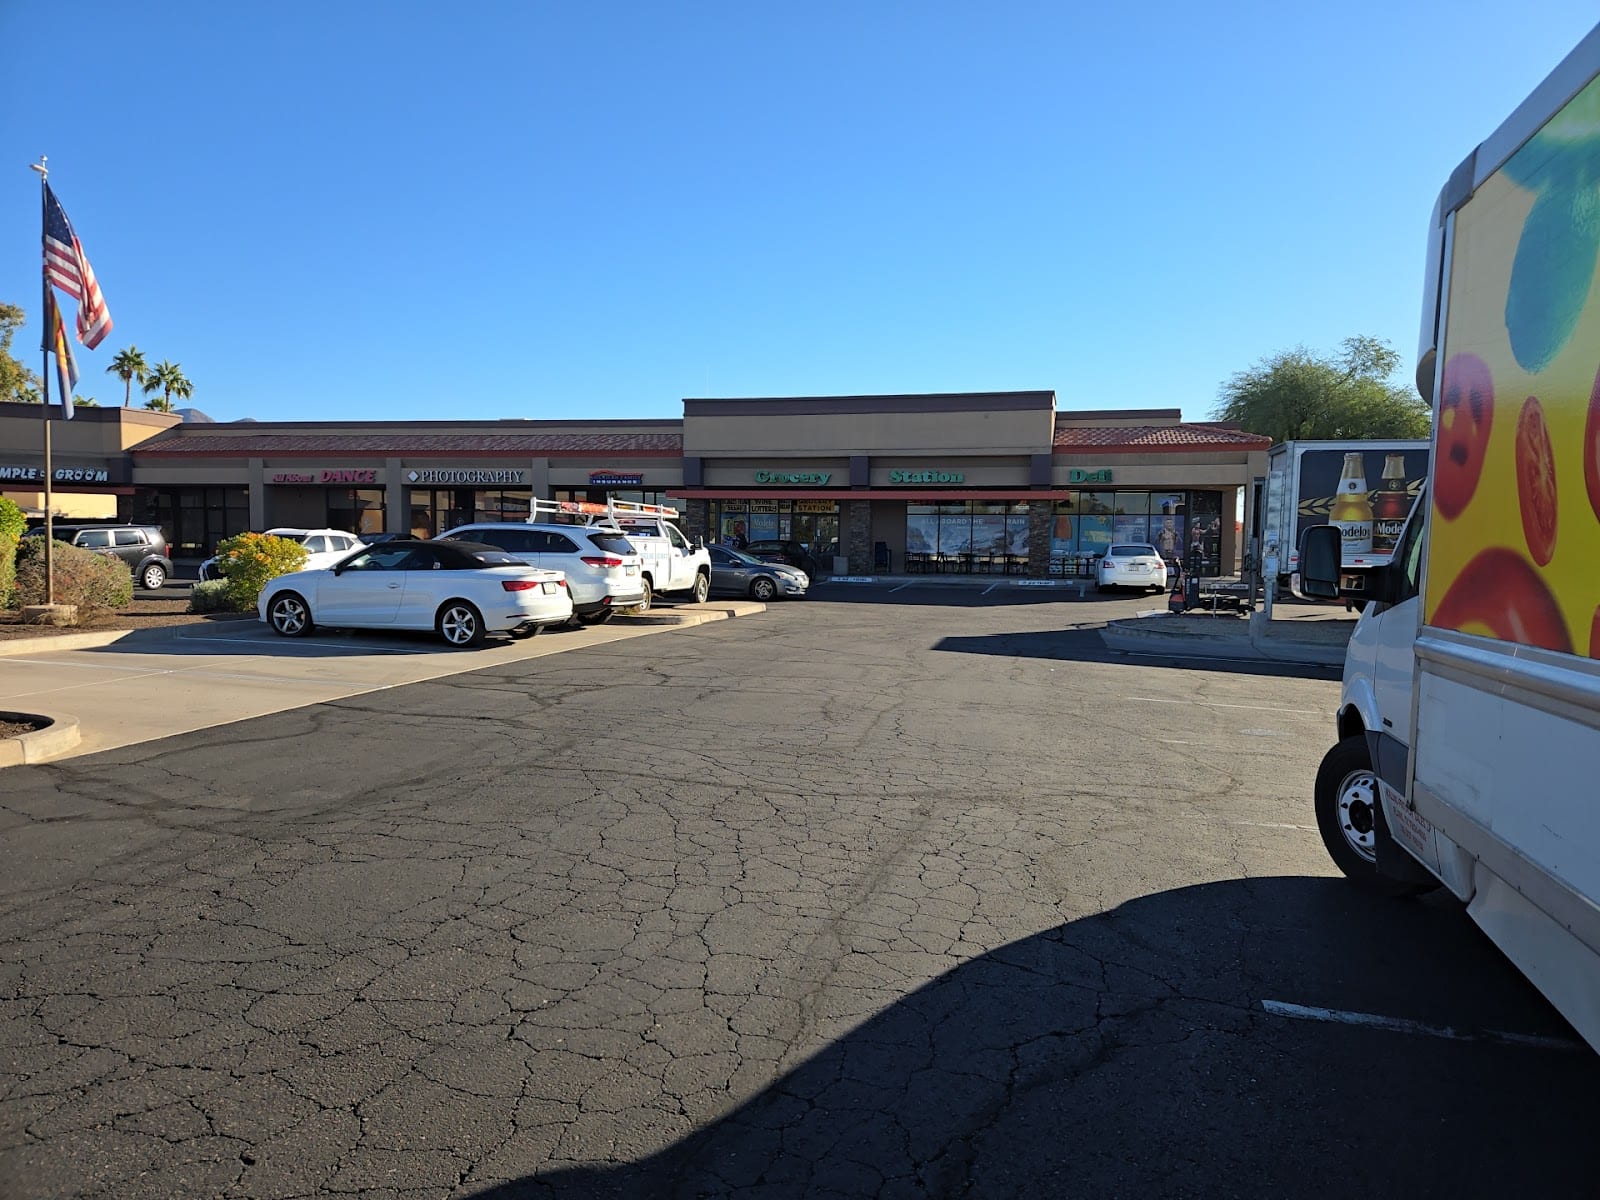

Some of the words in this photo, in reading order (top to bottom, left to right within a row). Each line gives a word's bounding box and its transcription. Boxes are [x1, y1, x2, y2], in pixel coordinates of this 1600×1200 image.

[55, 468, 108, 482] GROOM
[319, 469, 376, 483] DANCE
[420, 470, 523, 483] PHOTOGRAPHY
[755, 470, 832, 486] Grocery
[889, 469, 964, 484] Station
[1069, 468, 1113, 484] Deli
[1341, 525, 1367, 537] odelo
